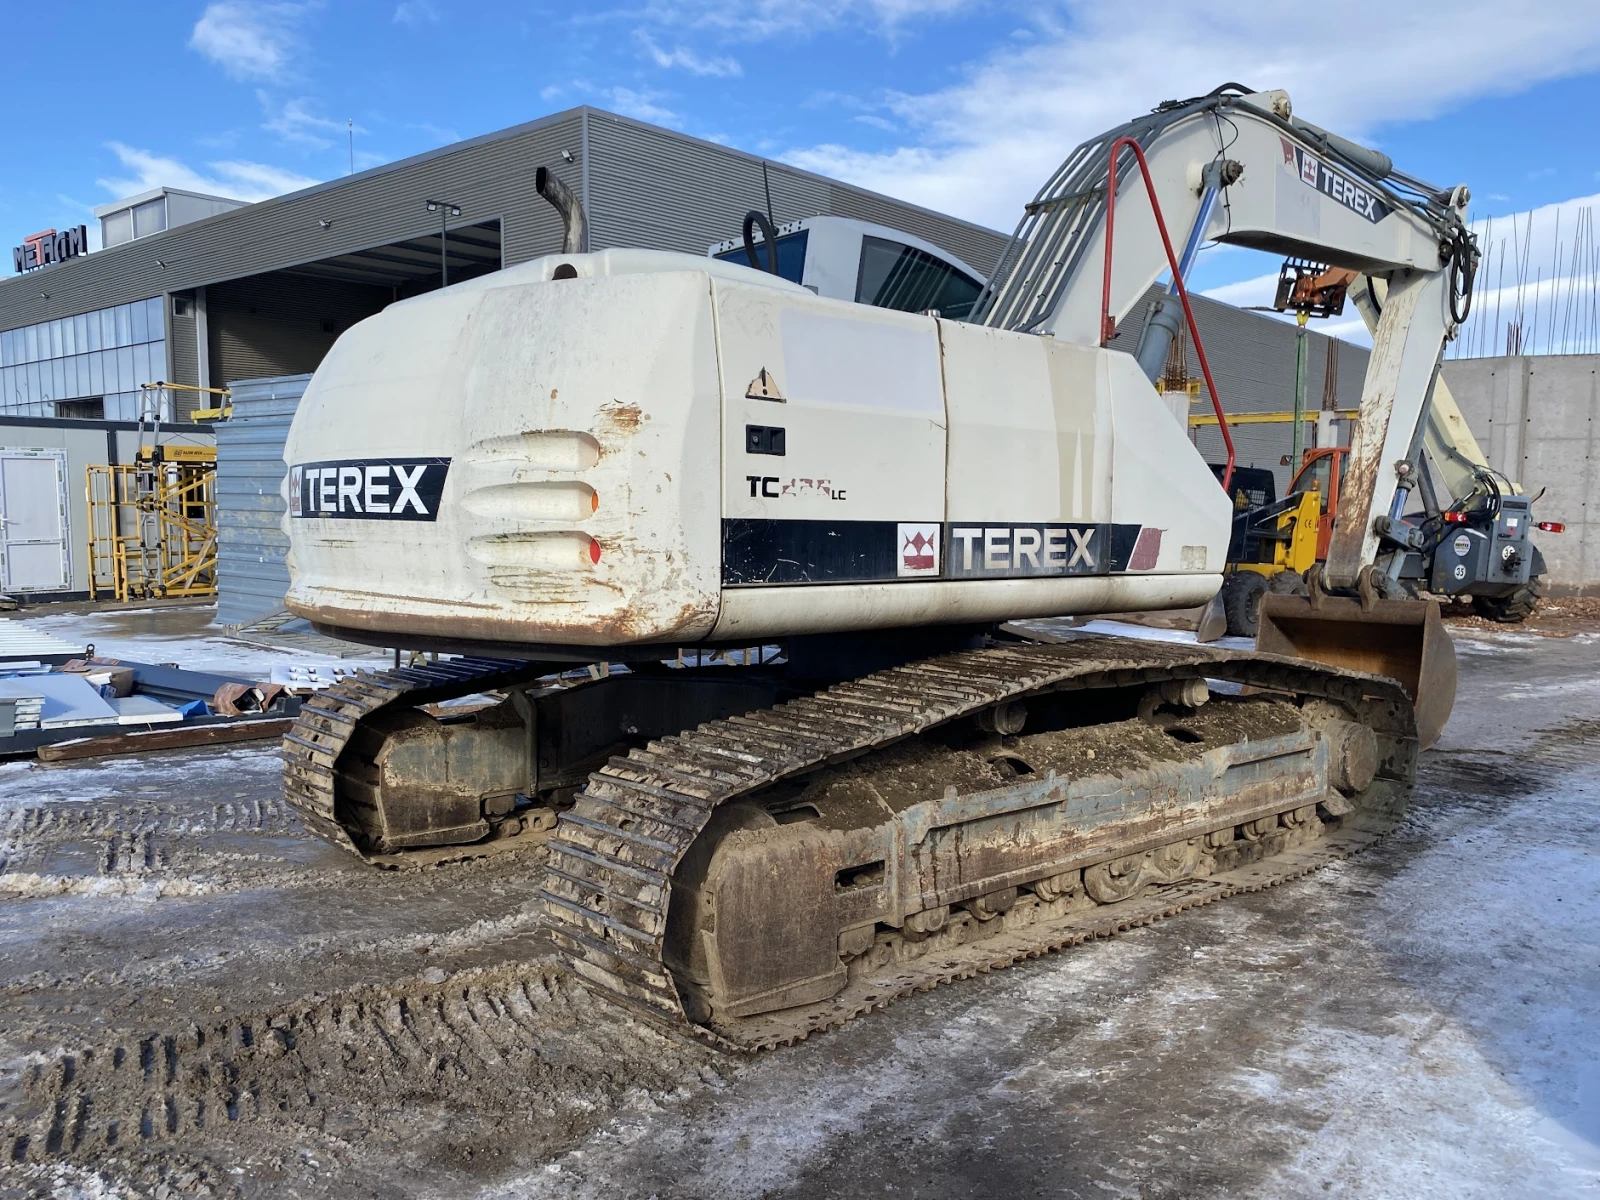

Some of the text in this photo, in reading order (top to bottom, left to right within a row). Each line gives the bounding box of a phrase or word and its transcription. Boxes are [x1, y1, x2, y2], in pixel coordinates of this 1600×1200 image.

[1322, 166, 1376, 221] TEREX
[306, 465, 430, 515] TEREX
[953, 528, 1096, 570] TEREX
[1456, 567, 1464, 577] 35
